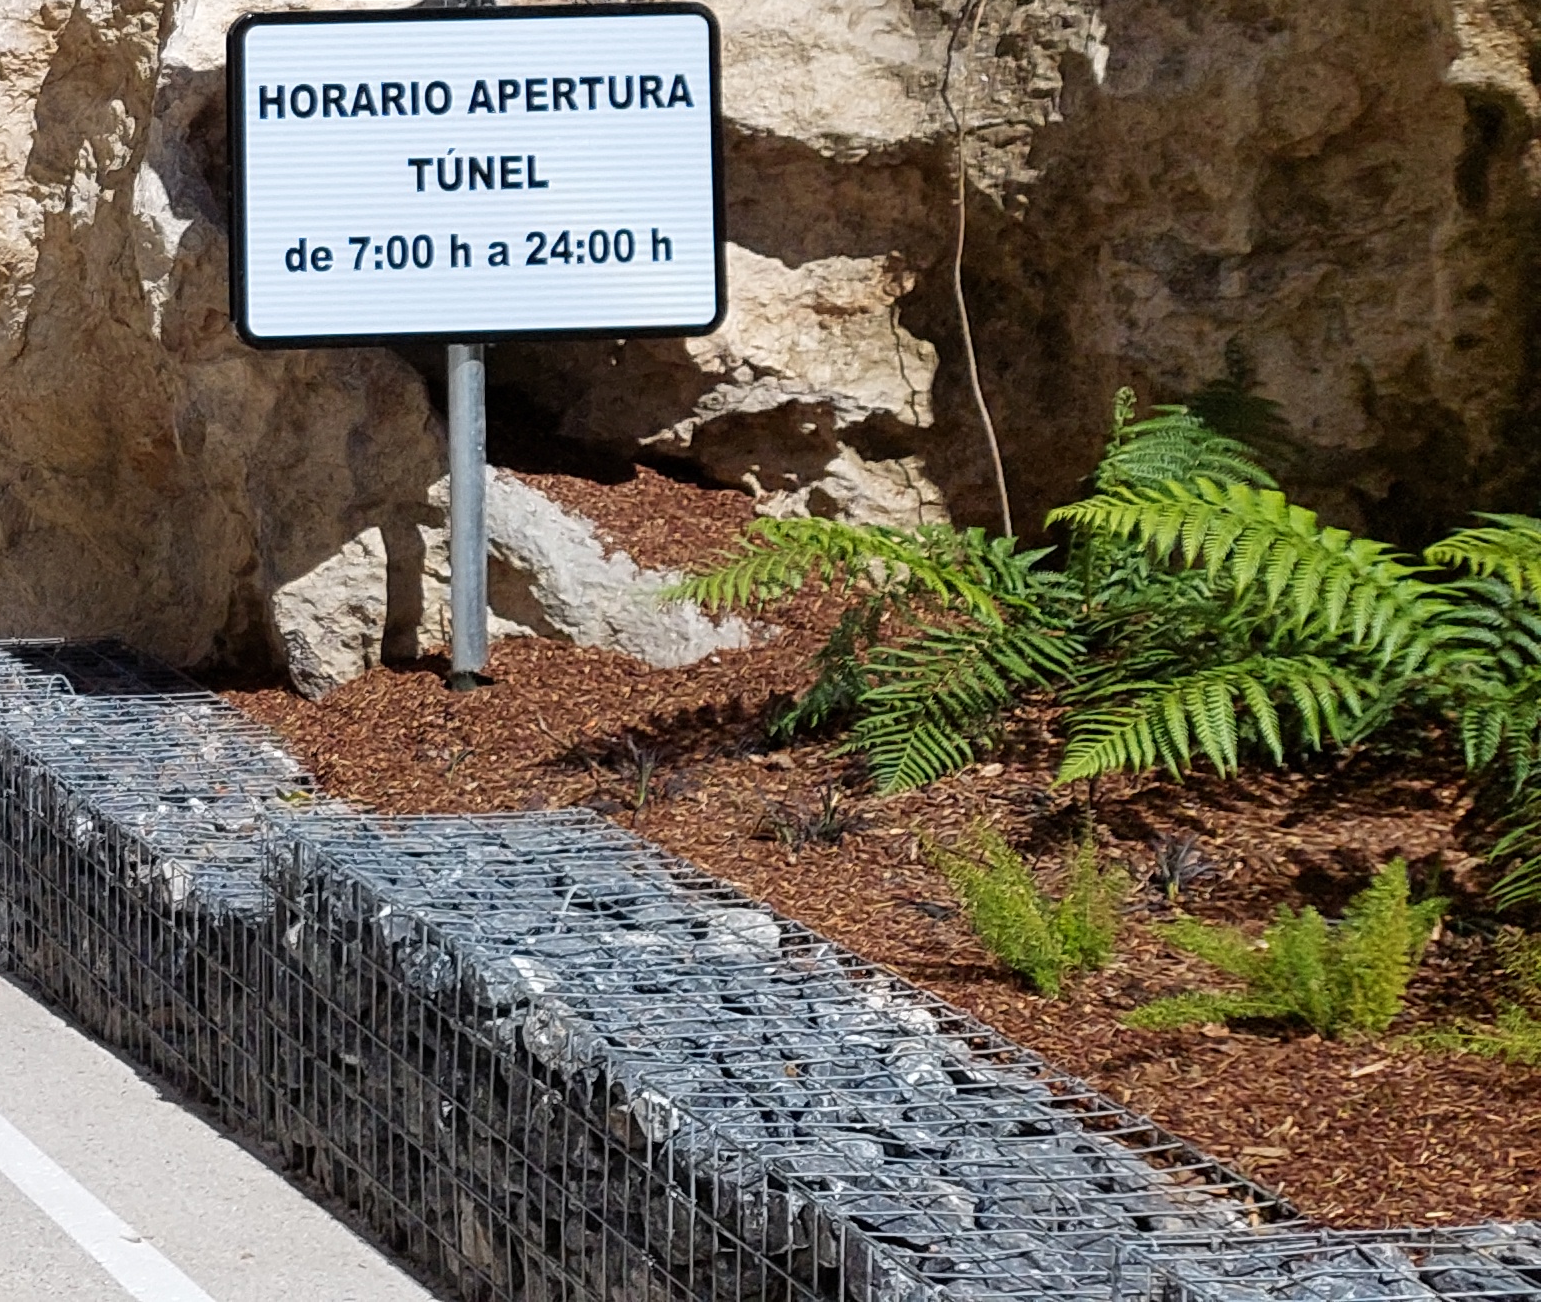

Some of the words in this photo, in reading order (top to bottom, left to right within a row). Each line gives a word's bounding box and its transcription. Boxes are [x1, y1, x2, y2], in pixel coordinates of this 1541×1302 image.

[260, 81, 451, 119] HORARIO
[468, 75, 694, 113] APERTURA
[408, 148, 548, 192] TÚNEL
[286, 238, 332, 272] de
[349, 235, 433, 270] 7:00
[451, 234, 471, 267] h
[488, 242, 509, 266] a
[526, 229, 634, 265] 24:00
[652, 228, 671, 261] h
